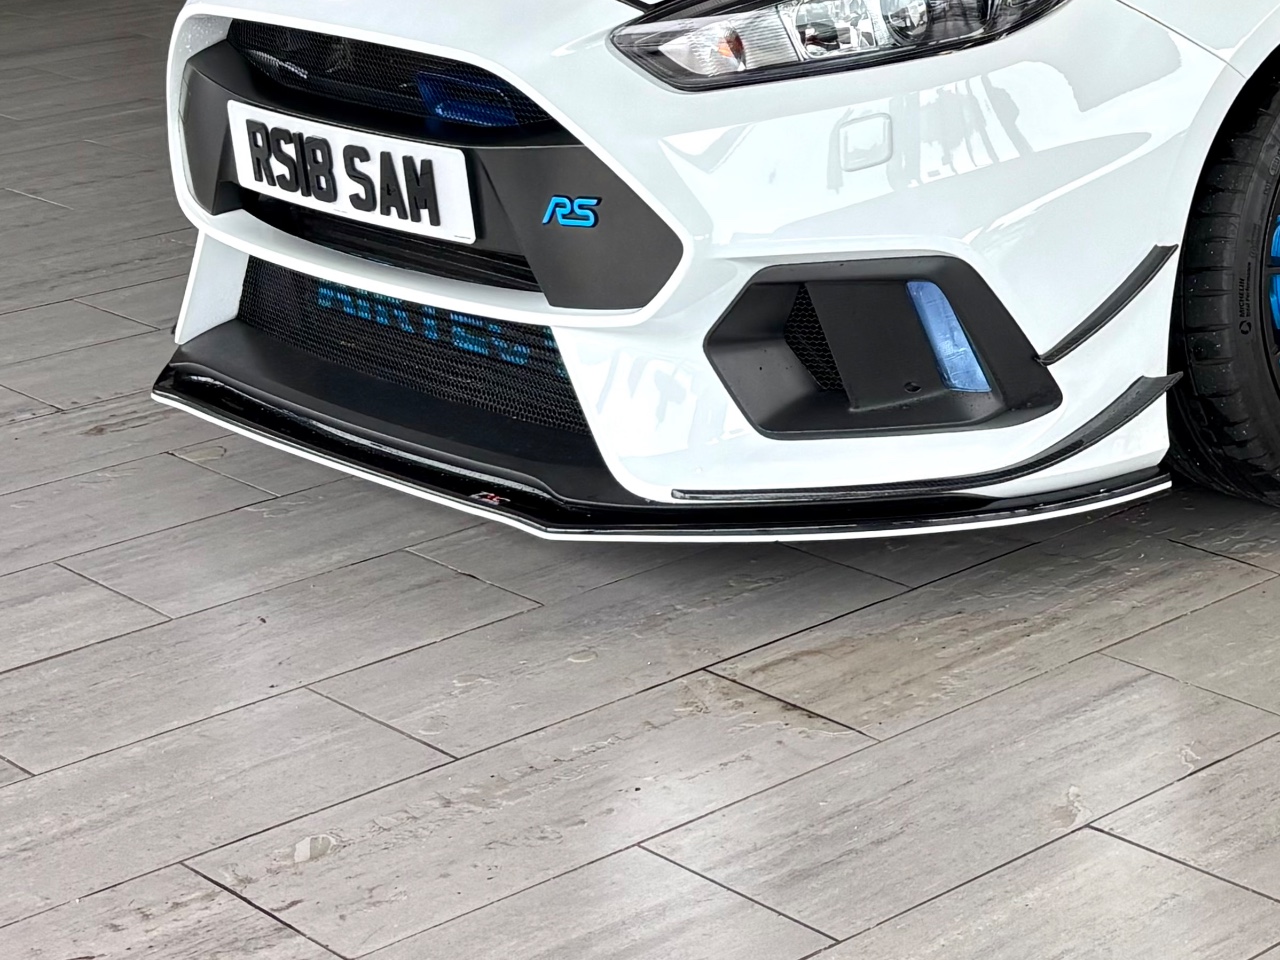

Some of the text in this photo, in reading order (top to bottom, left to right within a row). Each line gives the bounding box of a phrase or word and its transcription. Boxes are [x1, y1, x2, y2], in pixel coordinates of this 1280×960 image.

[246, 118, 441, 227] RS18 SAM
[542, 194, 602, 228] RS
[1238, 277, 1246, 318] MICHELIN
